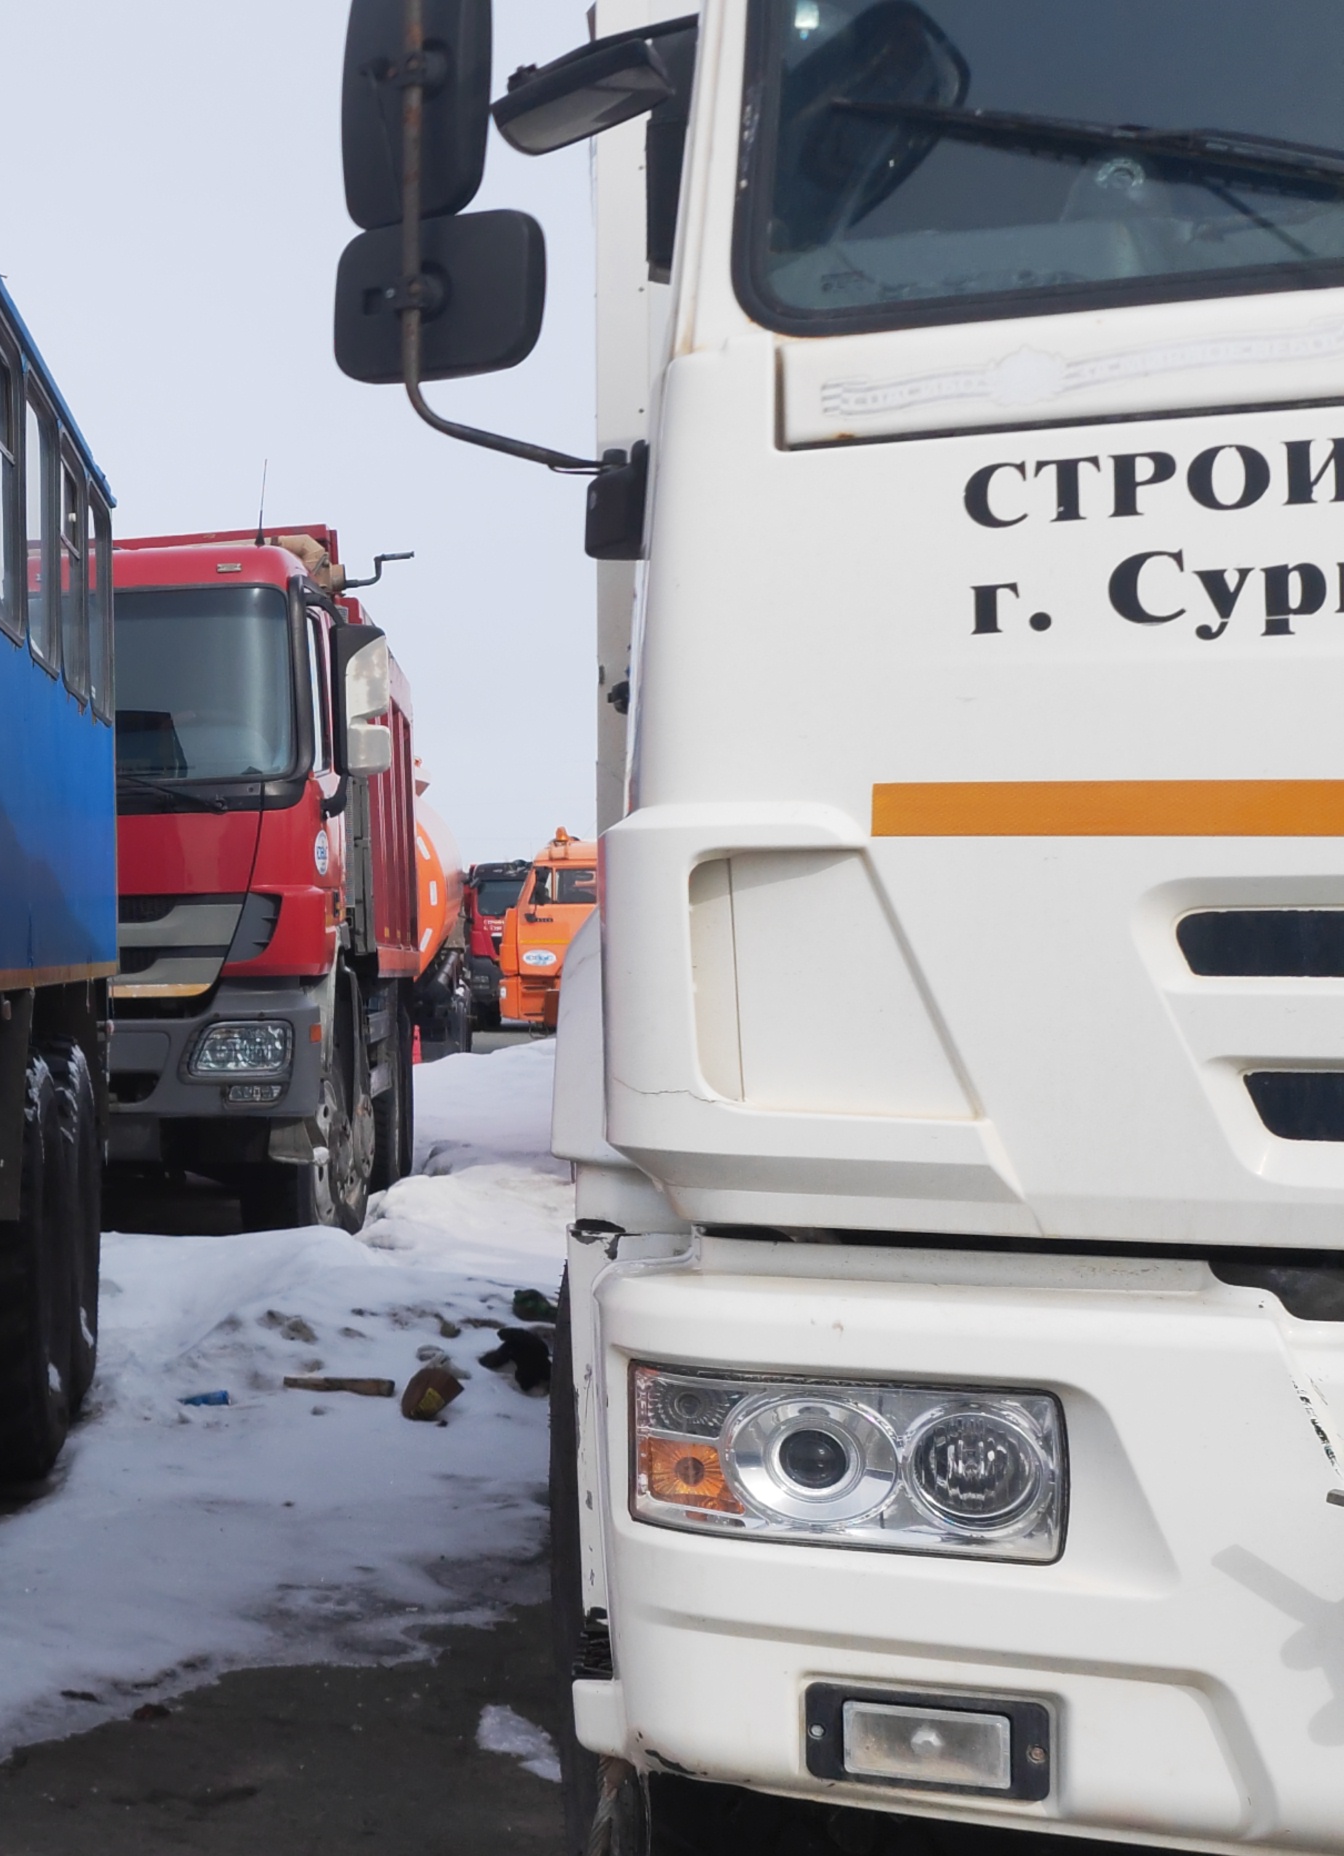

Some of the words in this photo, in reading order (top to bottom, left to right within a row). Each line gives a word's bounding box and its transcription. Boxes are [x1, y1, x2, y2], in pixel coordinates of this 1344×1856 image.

[963, 438, 1344, 529] СТРОИ
[970, 582, 1052, 635] г.
[1108, 548, 1344, 641] Сур
